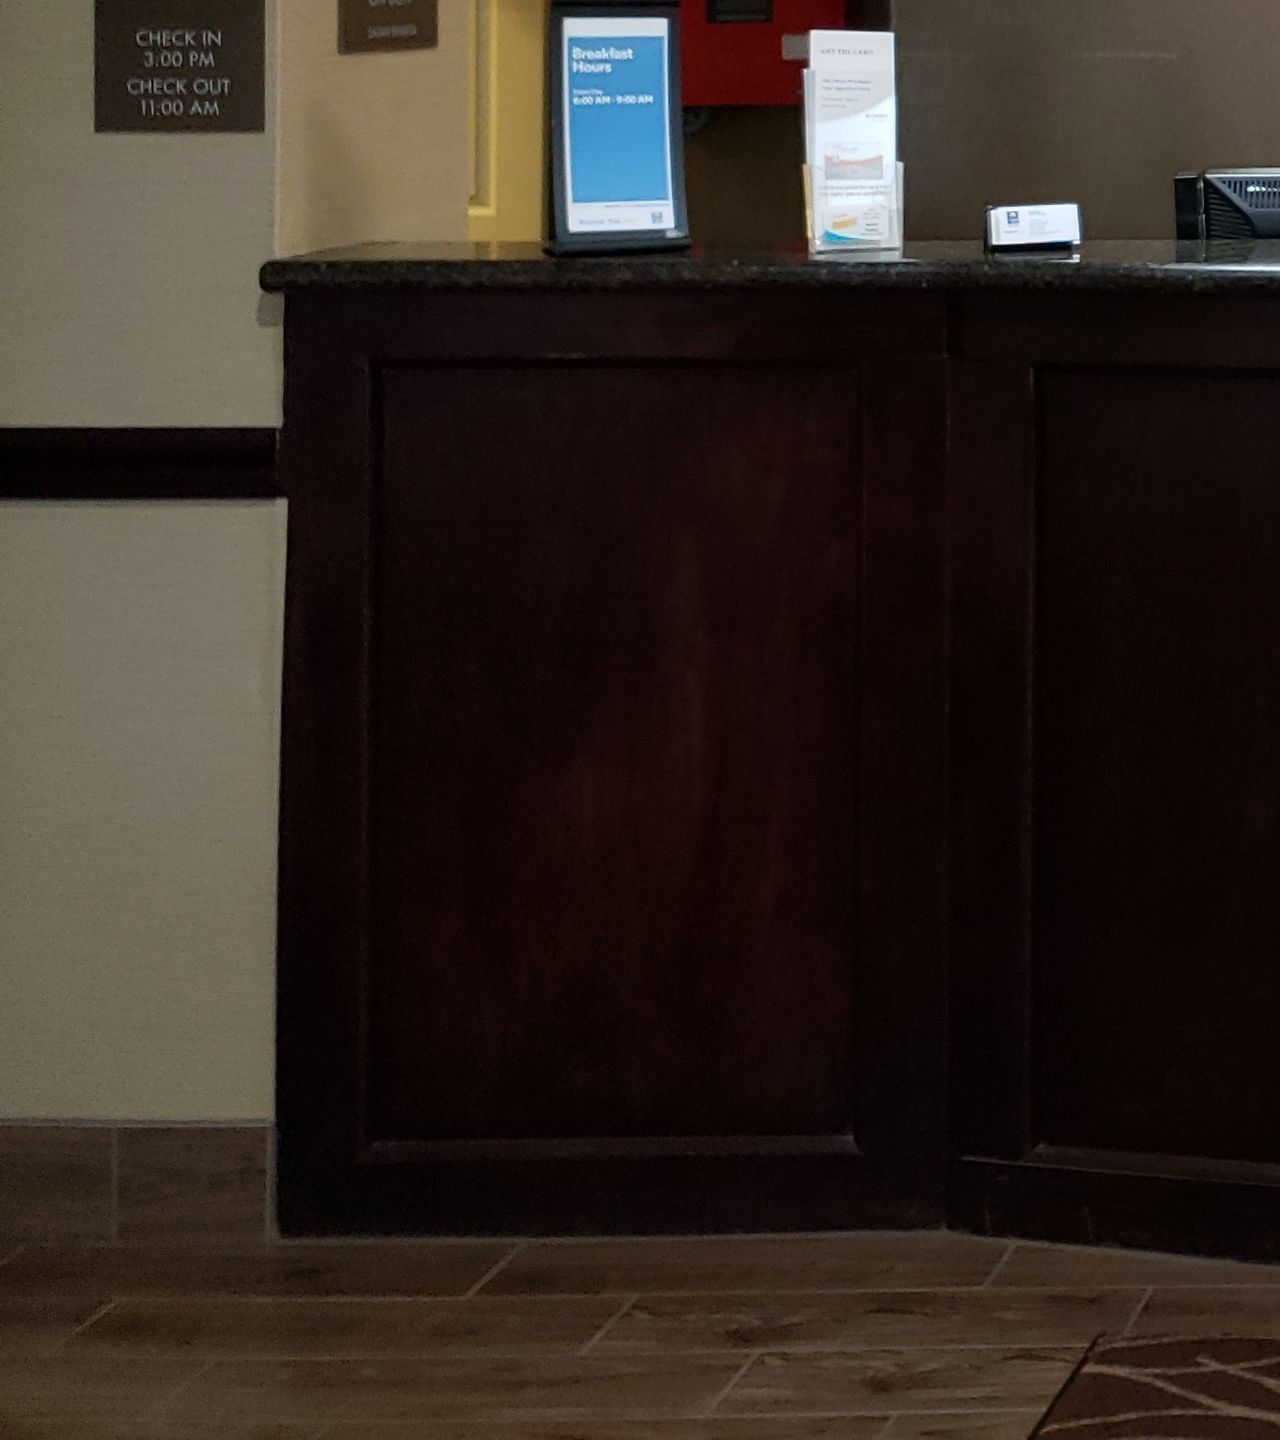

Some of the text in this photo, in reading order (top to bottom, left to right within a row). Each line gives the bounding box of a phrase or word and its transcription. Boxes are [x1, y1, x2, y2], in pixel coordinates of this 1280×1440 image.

[136, 29, 222, 48] CHECK IN
[189, 50, 215, 68] PM
[572, 46, 635, 61] Breakfast
[572, 61, 613, 74] Hours
[126, 78, 231, 96] CHECK OUT
[141, 99, 219, 116] 11:00 AM
[595, 95, 611, 105] AM
[638, 94, 654, 104] AM
